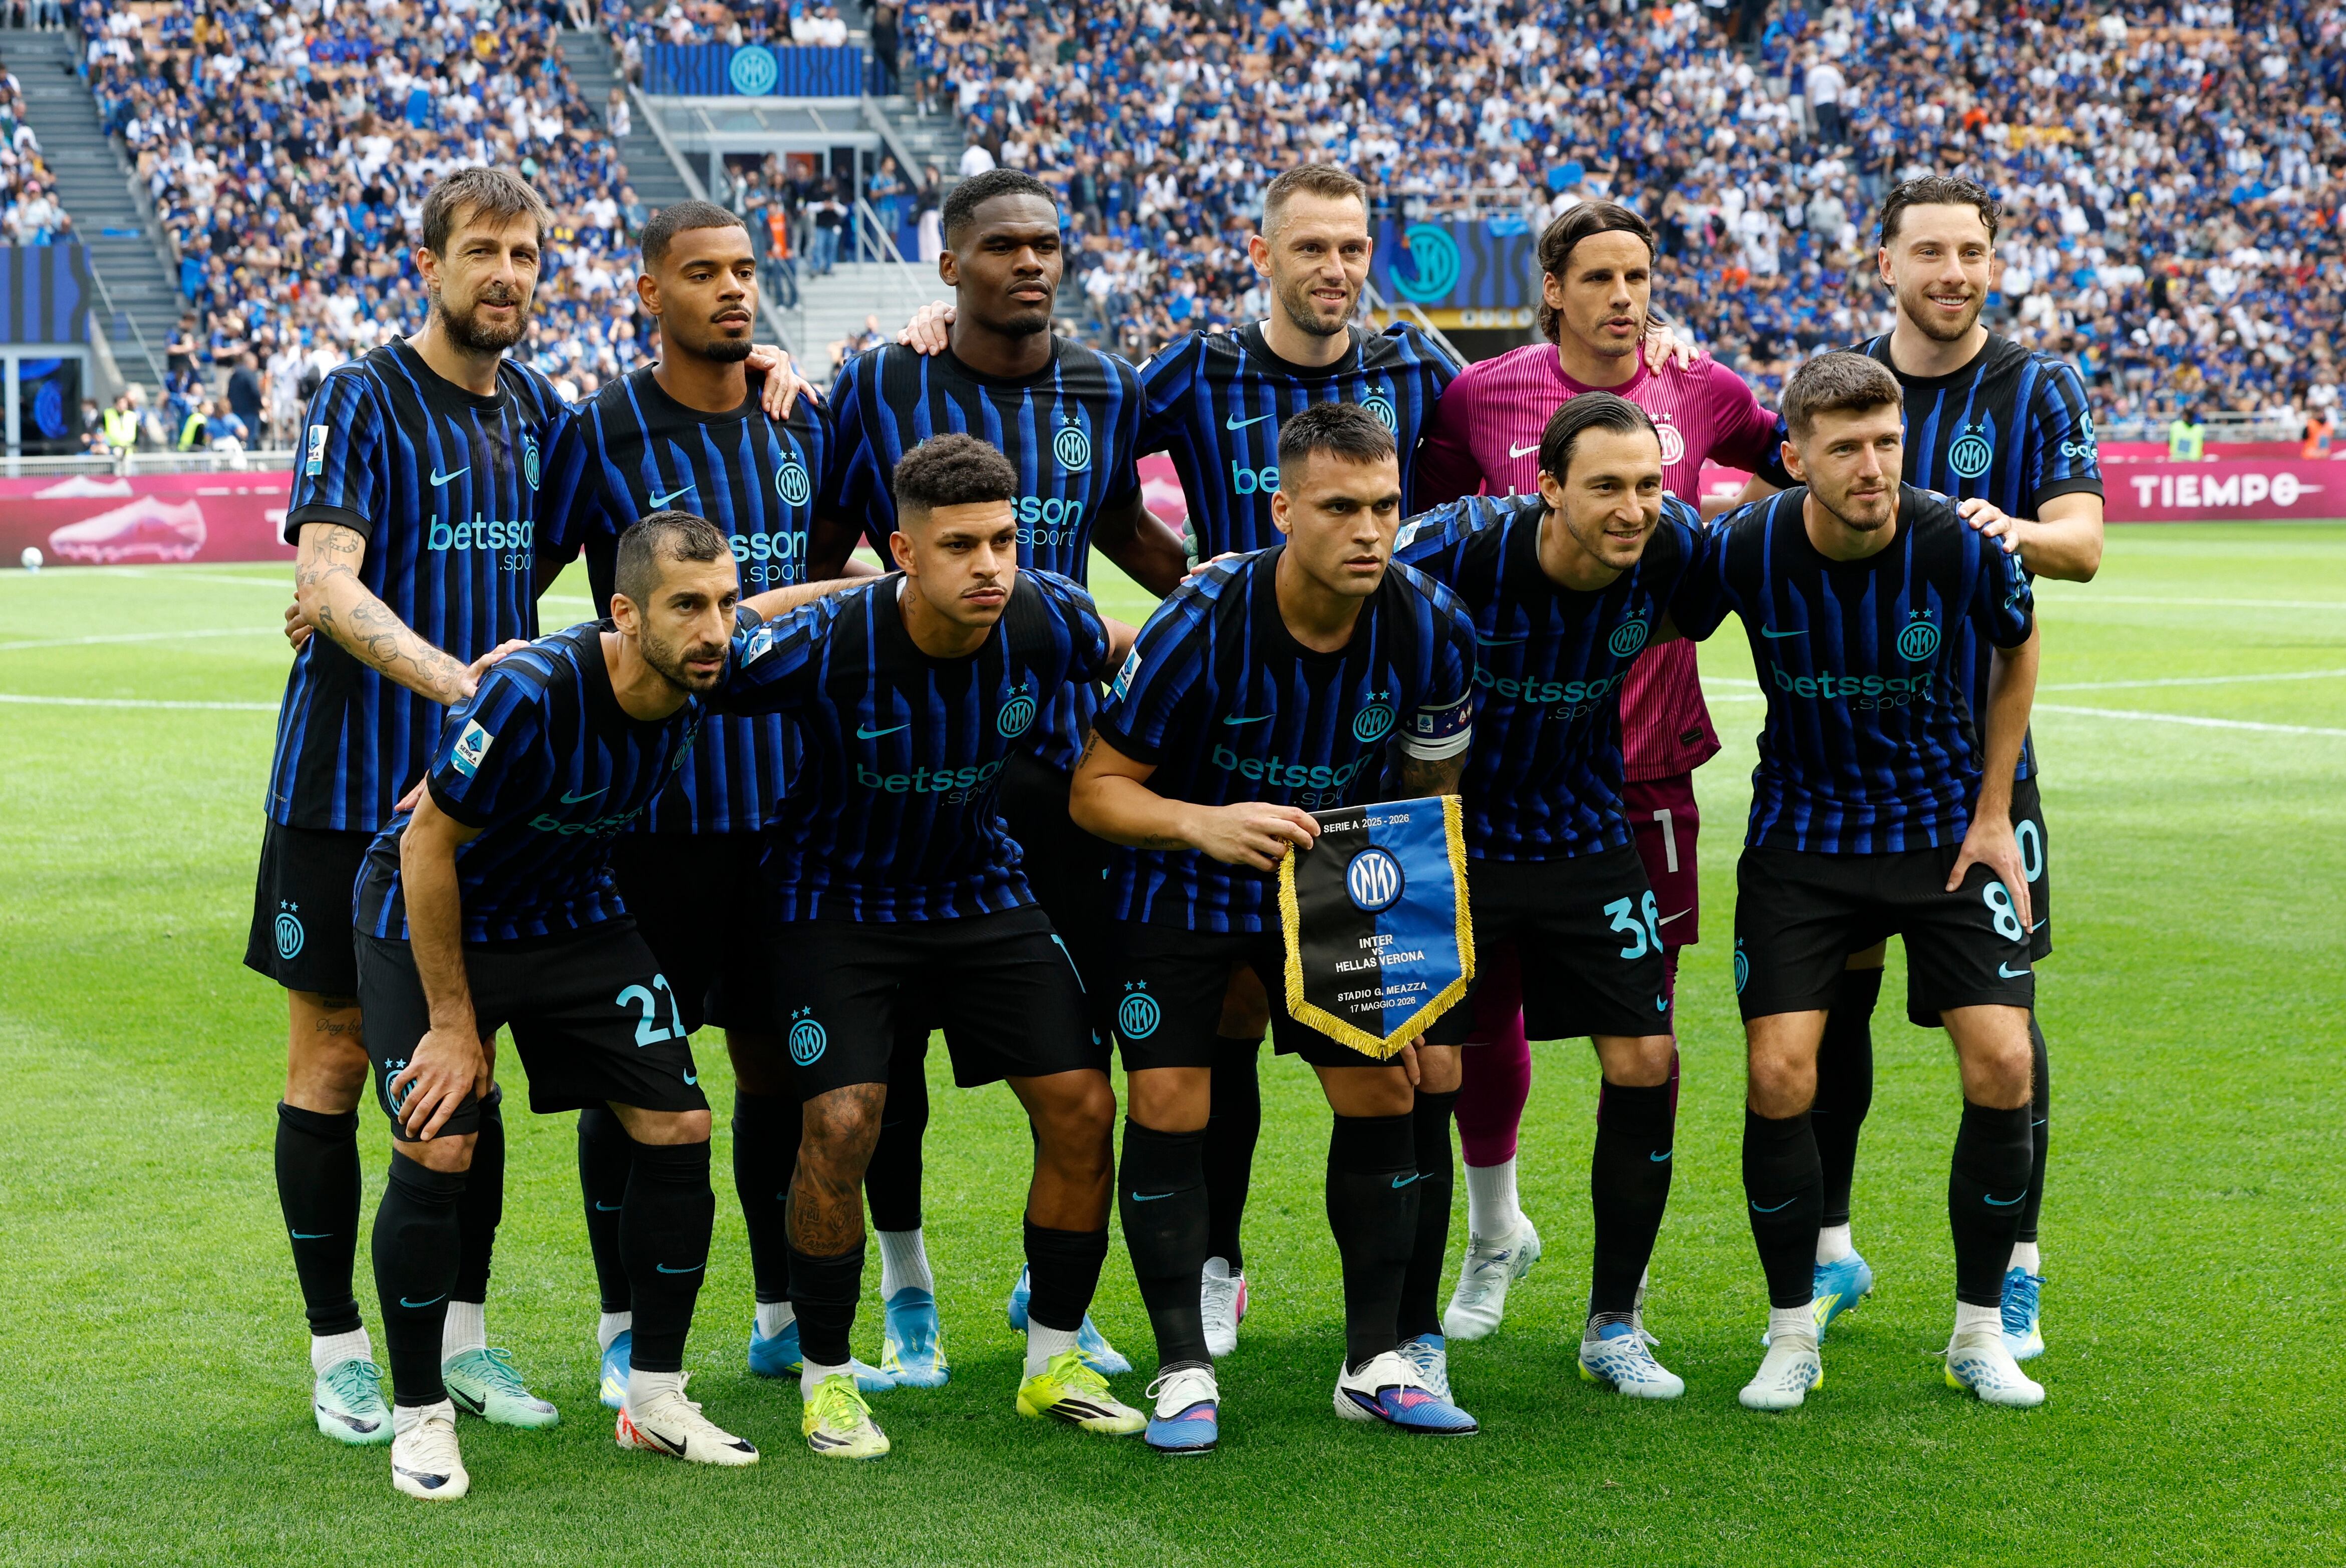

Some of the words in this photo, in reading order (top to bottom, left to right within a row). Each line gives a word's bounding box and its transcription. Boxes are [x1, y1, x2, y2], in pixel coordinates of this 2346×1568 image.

[2130, 472, 2300, 507] TIEMPO
[728, 531, 806, 562] sson
[745, 559, 805, 585] .sport
[1770, 660, 1932, 698] betsson
[459, 745, 473, 758] SERIE
[1324, 822, 1350, 833] SERIE
[1352, 821, 1359, 829] A
[1362, 817, 1381, 828] 2025
[1389, 814, 1409, 824] 2026
[1654, 809, 1678, 872] 1
[1983, 881, 2023, 942] 8
[1359, 934, 1393, 949] INTER
[1336, 957, 1377, 973] HELLAS
[1378, 950, 1425, 966] VERONA
[1338, 989, 1371, 1002] STADIO
[1386, 982, 1427, 995] MEAZZA
[1350, 1004, 1359, 1013] 17
[1361, 999, 1395, 1012] MAGGIO
[1397, 996, 1416, 1006] 2026
